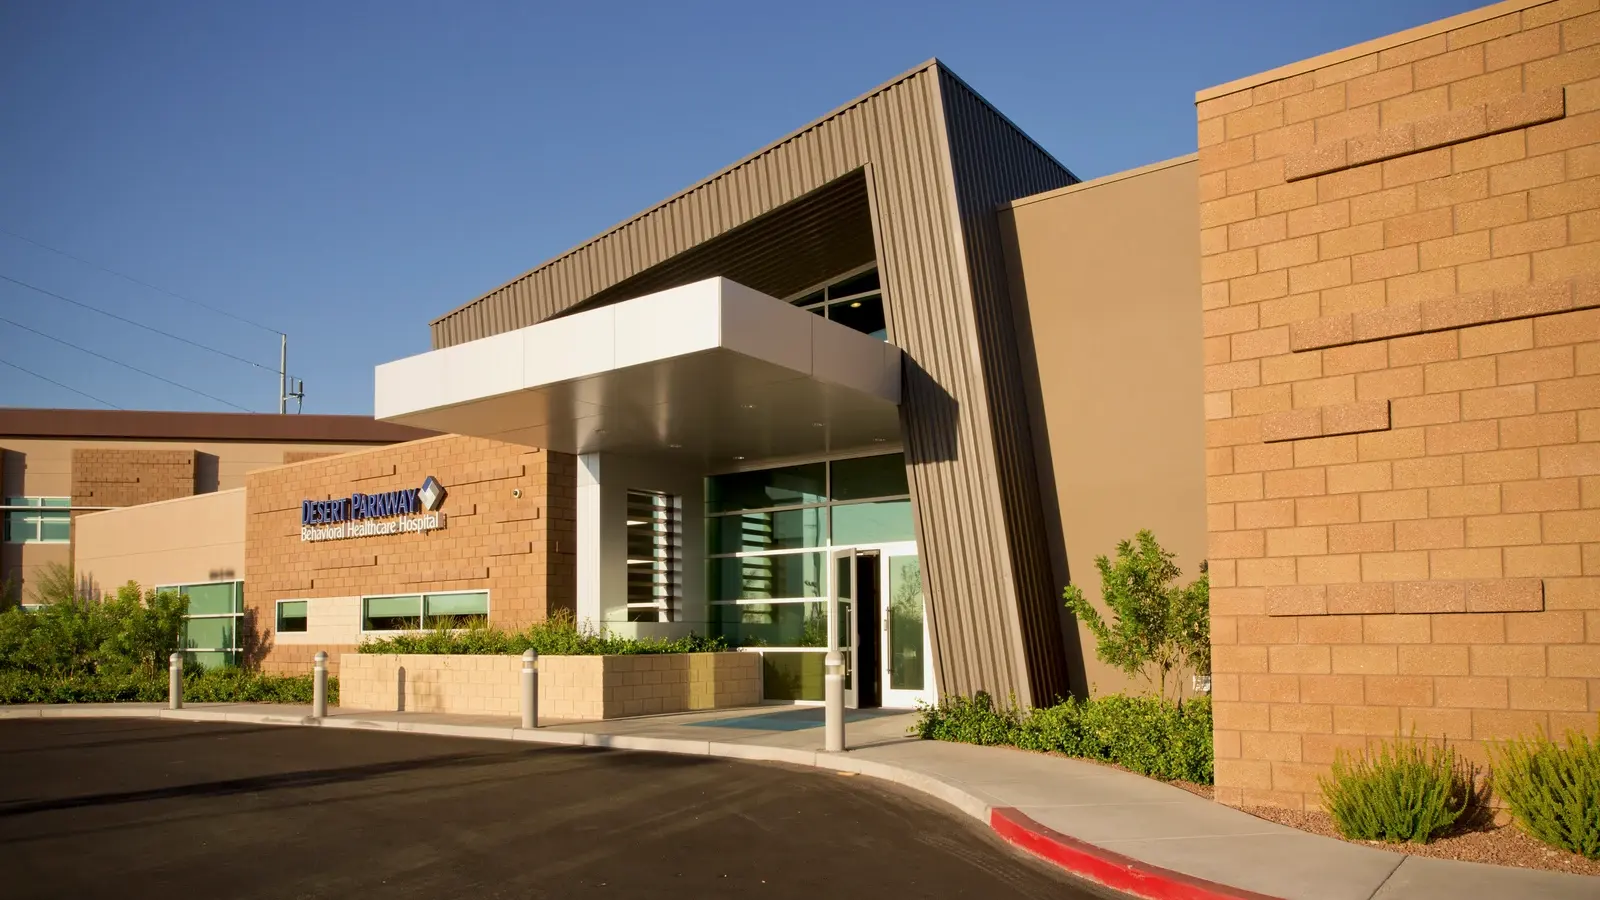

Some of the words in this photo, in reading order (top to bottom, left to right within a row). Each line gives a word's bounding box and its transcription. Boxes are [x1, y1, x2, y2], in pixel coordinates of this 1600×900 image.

[302, 499, 346, 525] DESERT
[352, 489, 418, 519] PARKWAY
[301, 524, 345, 541] Behavioral
[347, 519, 396, 537] Healthcare
[399, 511, 439, 534] Hospital
